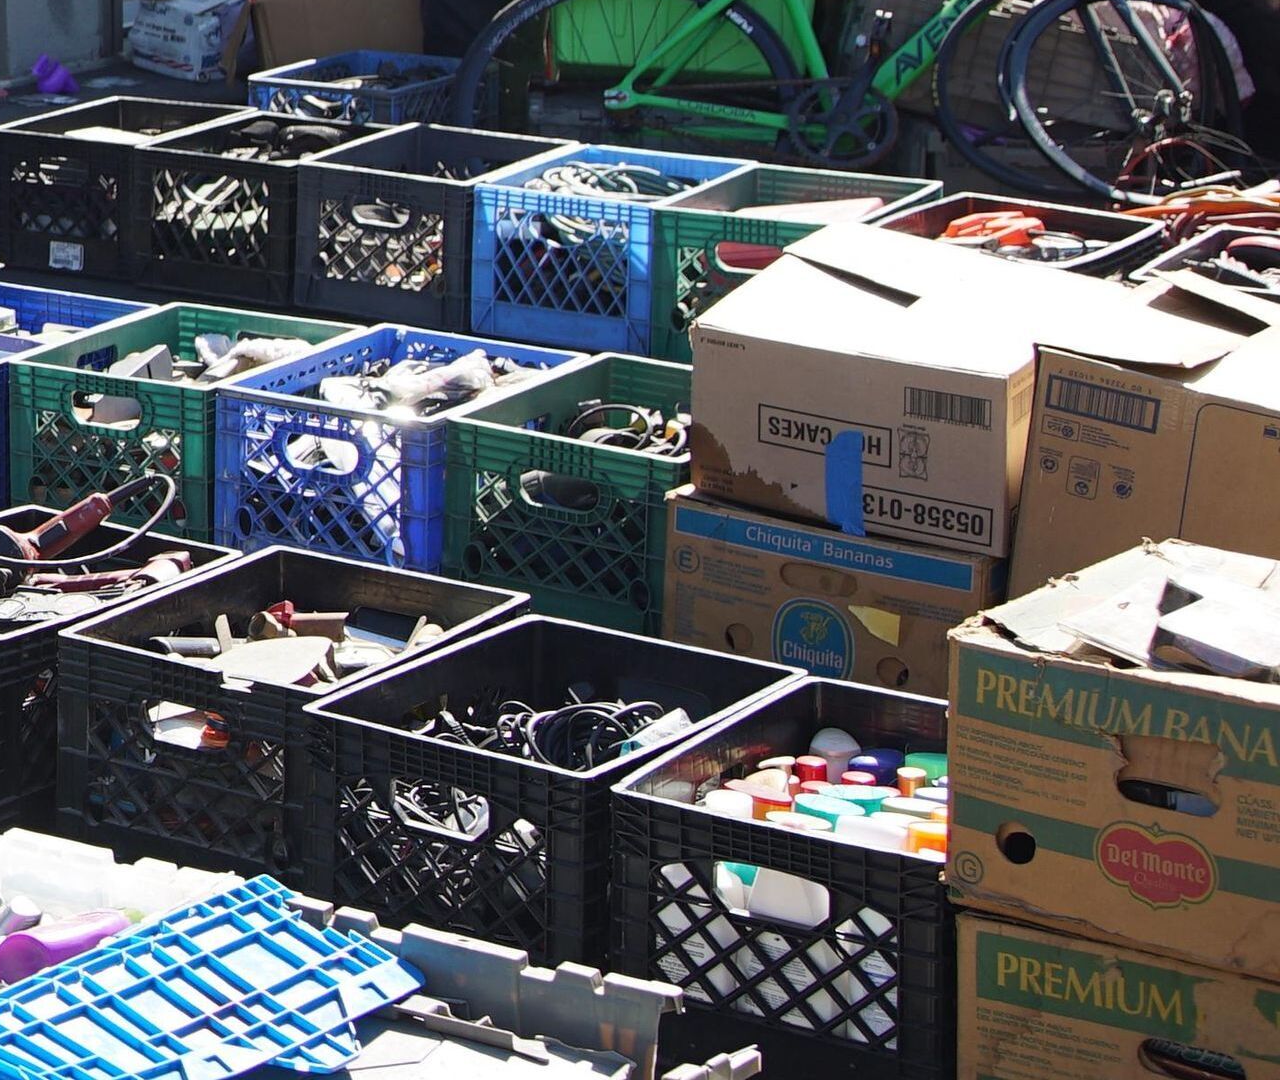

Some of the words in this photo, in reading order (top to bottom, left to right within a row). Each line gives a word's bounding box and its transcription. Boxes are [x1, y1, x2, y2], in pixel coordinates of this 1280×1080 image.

[768, 415, 832, 446] CAKES
[862, 493, 985, 537] 05358-013
[680, 551, 694, 568] E
[745, 525, 812, 554] Chiquita
[822, 541, 895, 569] Bananas
[782, 640, 844, 670] Chiquita
[975, 669, 1153, 736] PREMIUM
[960, 859, 978, 880] G
[1107, 843, 1139, 868] Del
[1140, 851, 1206, 884] Monte
[997, 951, 1183, 1025] PREMIUM
